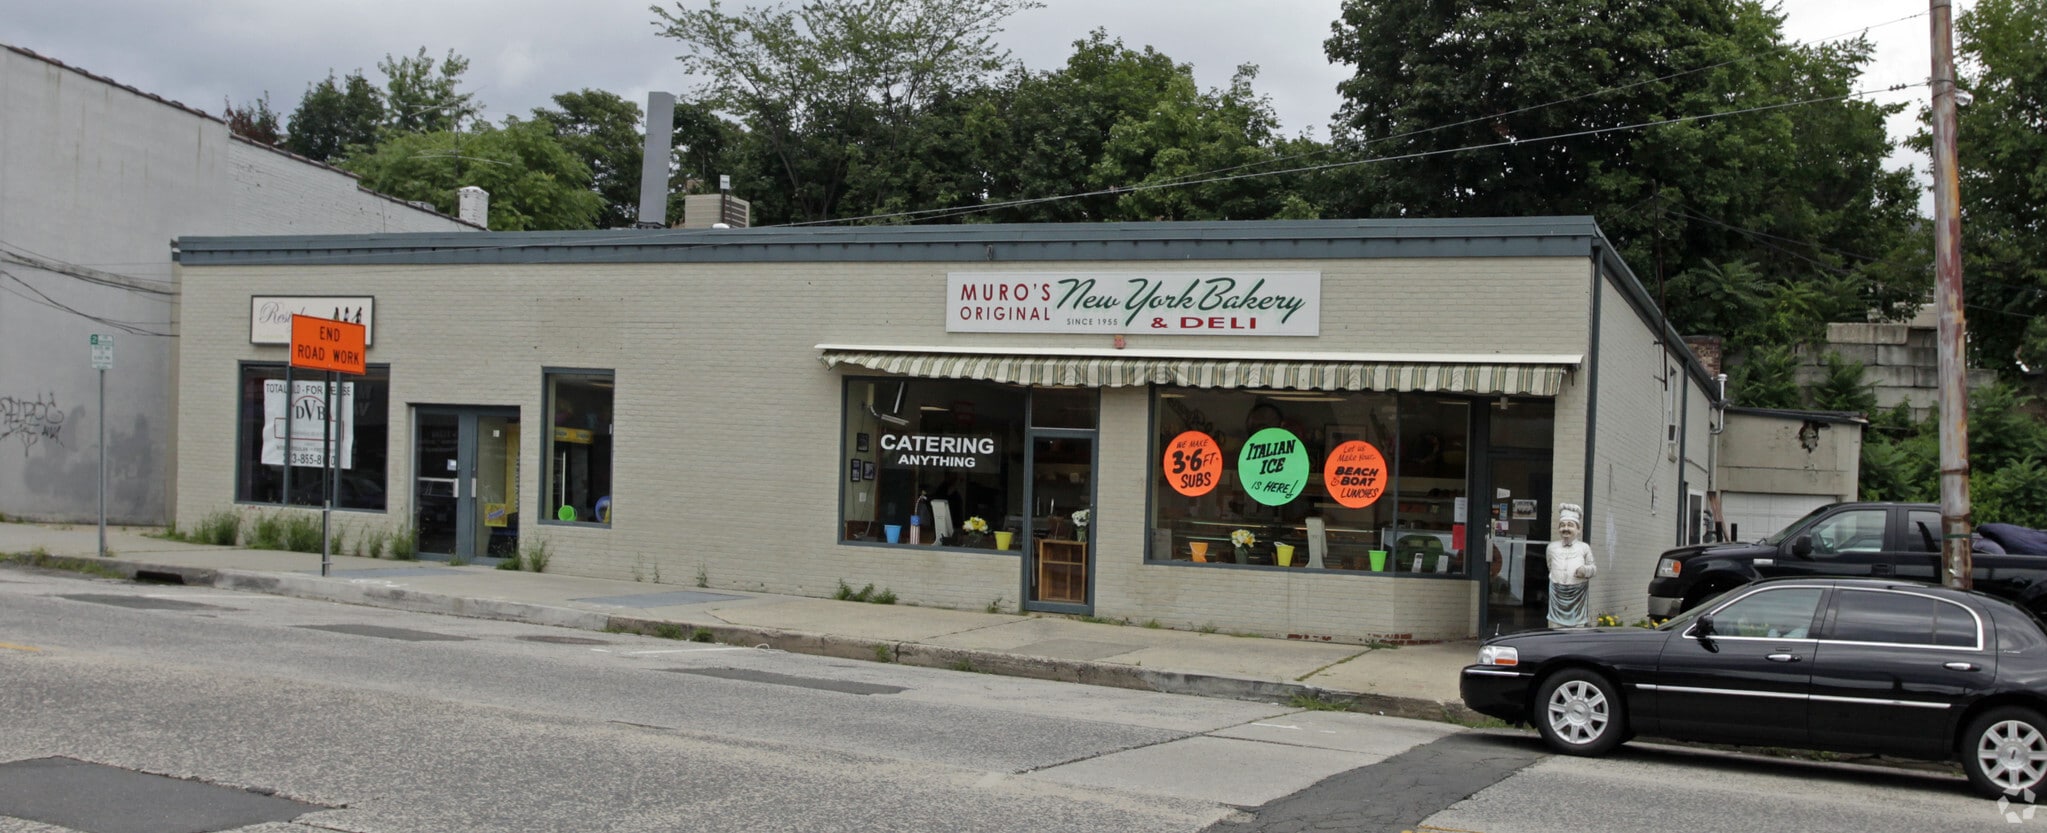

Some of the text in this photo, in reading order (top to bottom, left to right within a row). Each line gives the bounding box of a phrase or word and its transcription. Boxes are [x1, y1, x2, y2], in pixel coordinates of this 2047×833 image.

[960, 283, 1051, 301] MURO'S
[1056, 277, 1306, 327] New York Bakery
[960, 306, 1050, 321] ORIGINAL
[1066, 318, 1118, 326] SINCE 1955
[1151, 316, 1257, 330] & DELI
[320, 326, 341, 342] END
[297, 344, 360, 365] ROAD WORK
[306, 385, 323, 395] FOR
[880, 434, 995, 455] CATERING
[1189, 439, 1209, 448] MAKE
[1246, 439, 1297, 461] ITALIAN
[1343, 445, 1355, 453] Let
[898, 454, 976, 468] ANYTHING
[1337, 454, 1357, 462] Make
[1259, 457, 1287, 475] ICE
[1335, 466, 1379, 477] BEACH
[1180, 472, 1212, 489] SUBS
[1340, 476, 1376, 487] BOAT
[1251, 480, 1299, 499] IS HERE!
[1340, 487, 1380, 499] LUNCHES
